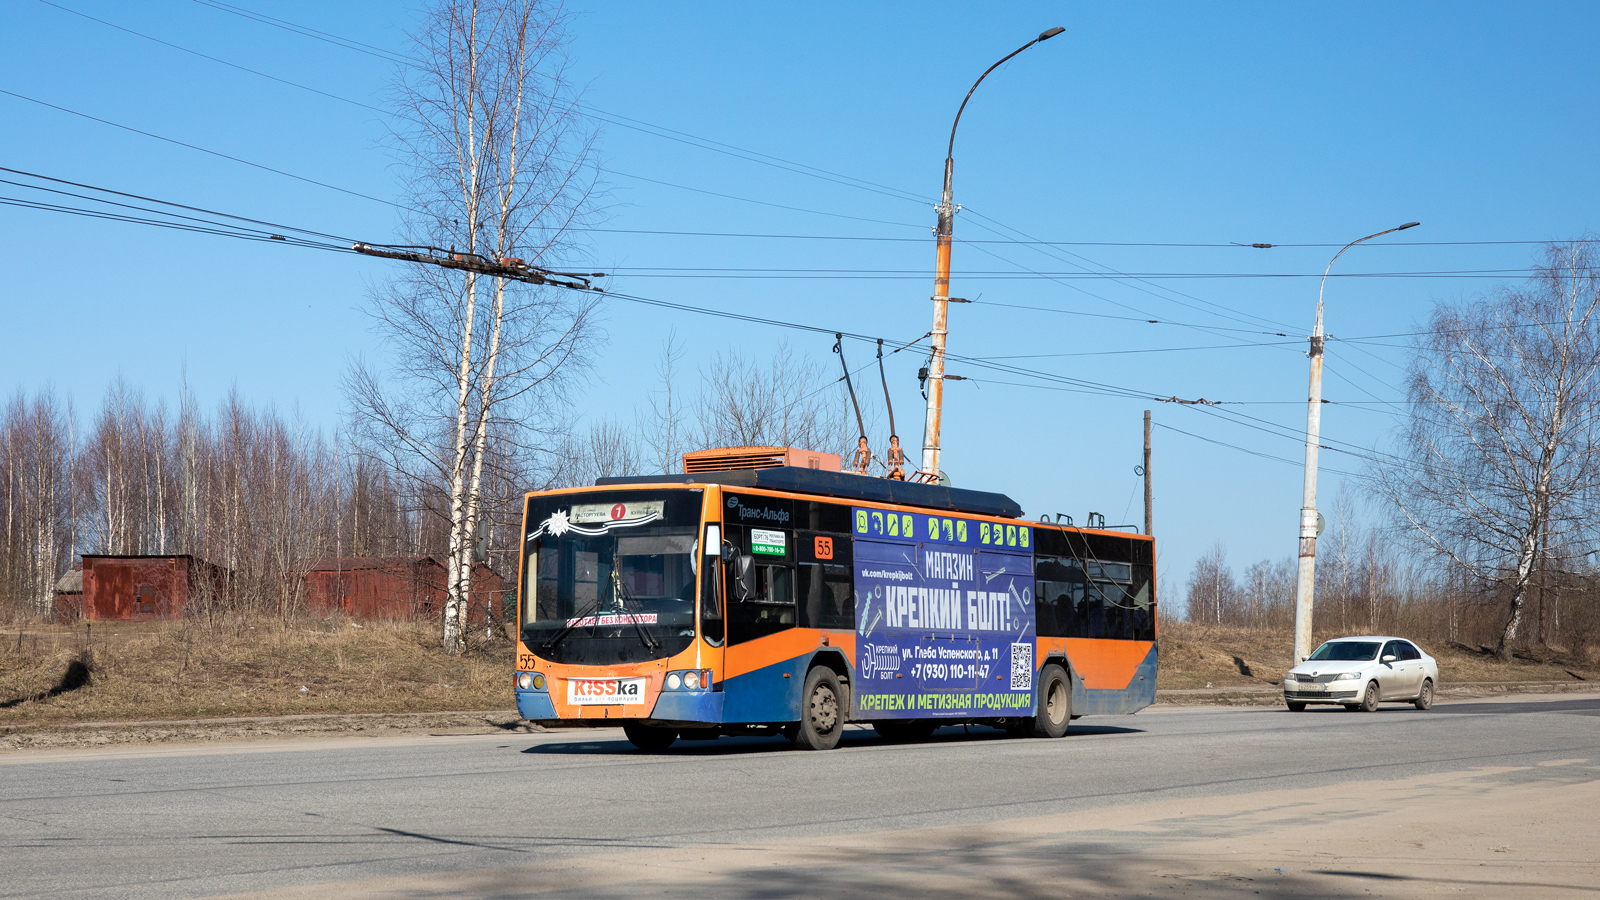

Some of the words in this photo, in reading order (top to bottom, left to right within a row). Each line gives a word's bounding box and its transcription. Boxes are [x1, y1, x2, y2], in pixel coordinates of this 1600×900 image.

[615, 506, 622, 518] 1
[738, 504, 790, 524] Транс-Альфа
[818, 540, 830, 555] 55
[926, 551, 973, 581] МАГАЗИН
[886, 582, 961, 629] КРЕПКИЙ
[967, 590, 1011, 631] БОЛТ!
[876, 644, 898, 654] КРЕПКИЙ
[902, 648, 913, 661] ул.
[914, 646, 936, 659] Глеба
[938, 646, 983, 661] Успенского,
[984, 650, 990, 661] д.
[992, 648, 998, 660] 11
[520, 654, 535, 670] 55
[880, 672, 893, 680] БОЛТ
[911, 664, 922, 678] +7
[922, 664, 948, 681] (930)
[950, 664, 989, 679] 110-11-47
[860, 694, 905, 710] КРЕПЕЖ
[908, 694, 915, 709] И
[917, 694, 972, 709] МЕТИЗНАЯ
[974, 693, 1031, 710] ПРОДУКЦИЯ
